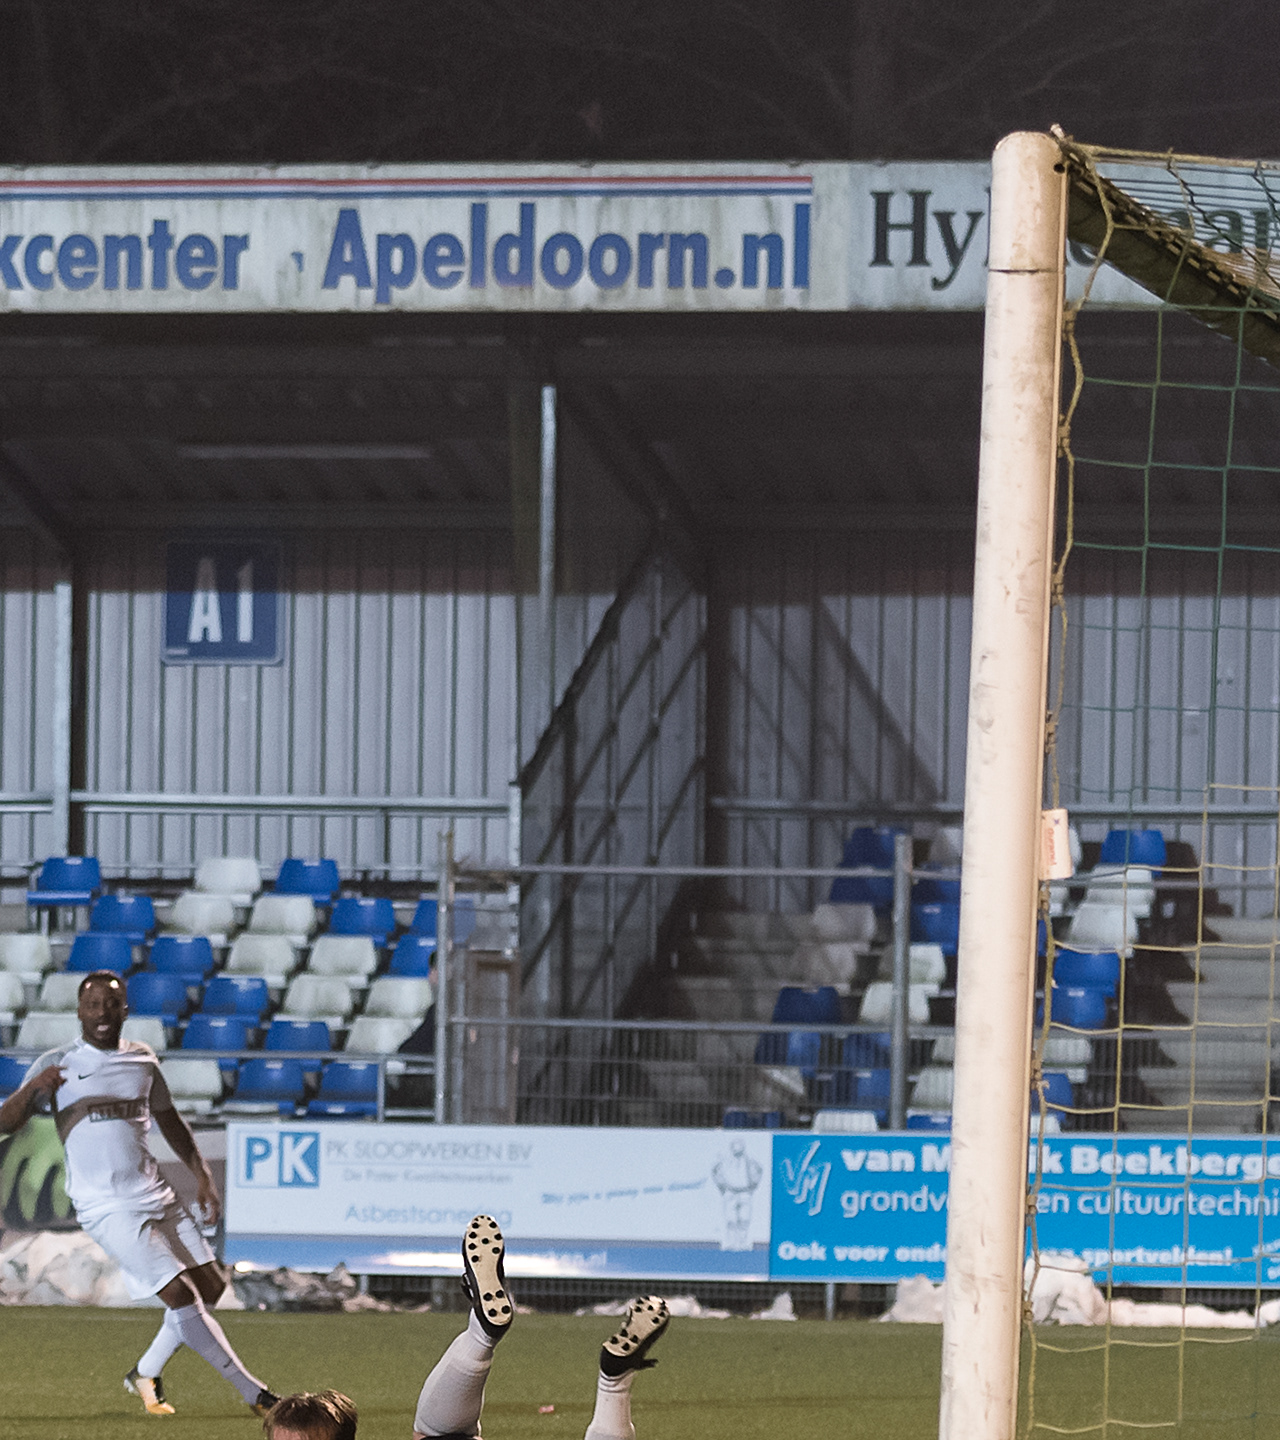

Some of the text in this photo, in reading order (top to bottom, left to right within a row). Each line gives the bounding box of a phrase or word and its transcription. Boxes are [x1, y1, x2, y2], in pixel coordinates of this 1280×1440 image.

[322, 202, 811, 304] Apeldoorn.nl
[187, 557, 254, 643] A1
[246, 1133, 317, 1184] PK
[841, 1149, 916, 1173] van
[344, 1205, 512, 1229] Asbestsaneg
[777, 1240, 827, 1262] Ook
[832, 1245, 890, 1263] voor
